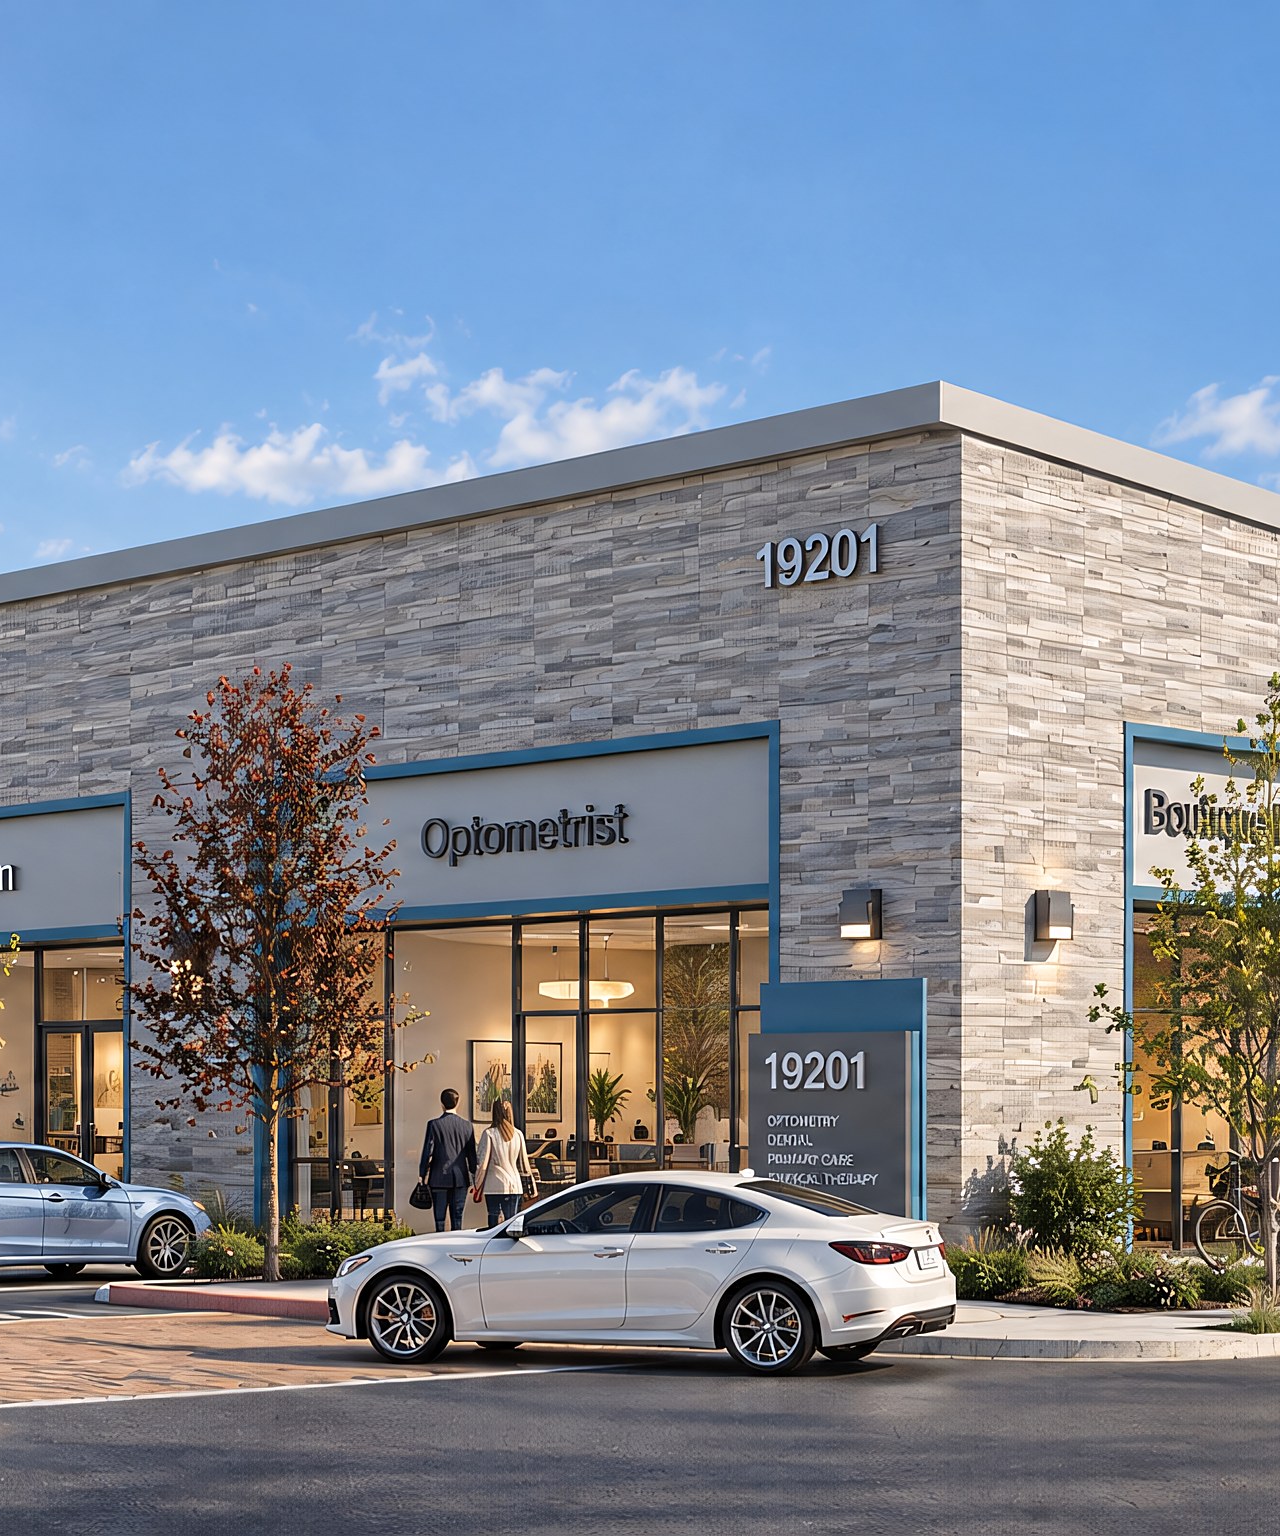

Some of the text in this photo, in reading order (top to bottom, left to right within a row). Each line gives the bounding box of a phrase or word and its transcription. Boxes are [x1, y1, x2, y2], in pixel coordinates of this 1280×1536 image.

[756, 523, 879, 588] 19201
[421, 804, 629, 867] Optometrist
[1144, 788, 1268, 850] Bouque
[765, 1050, 866, 1090] 19201
